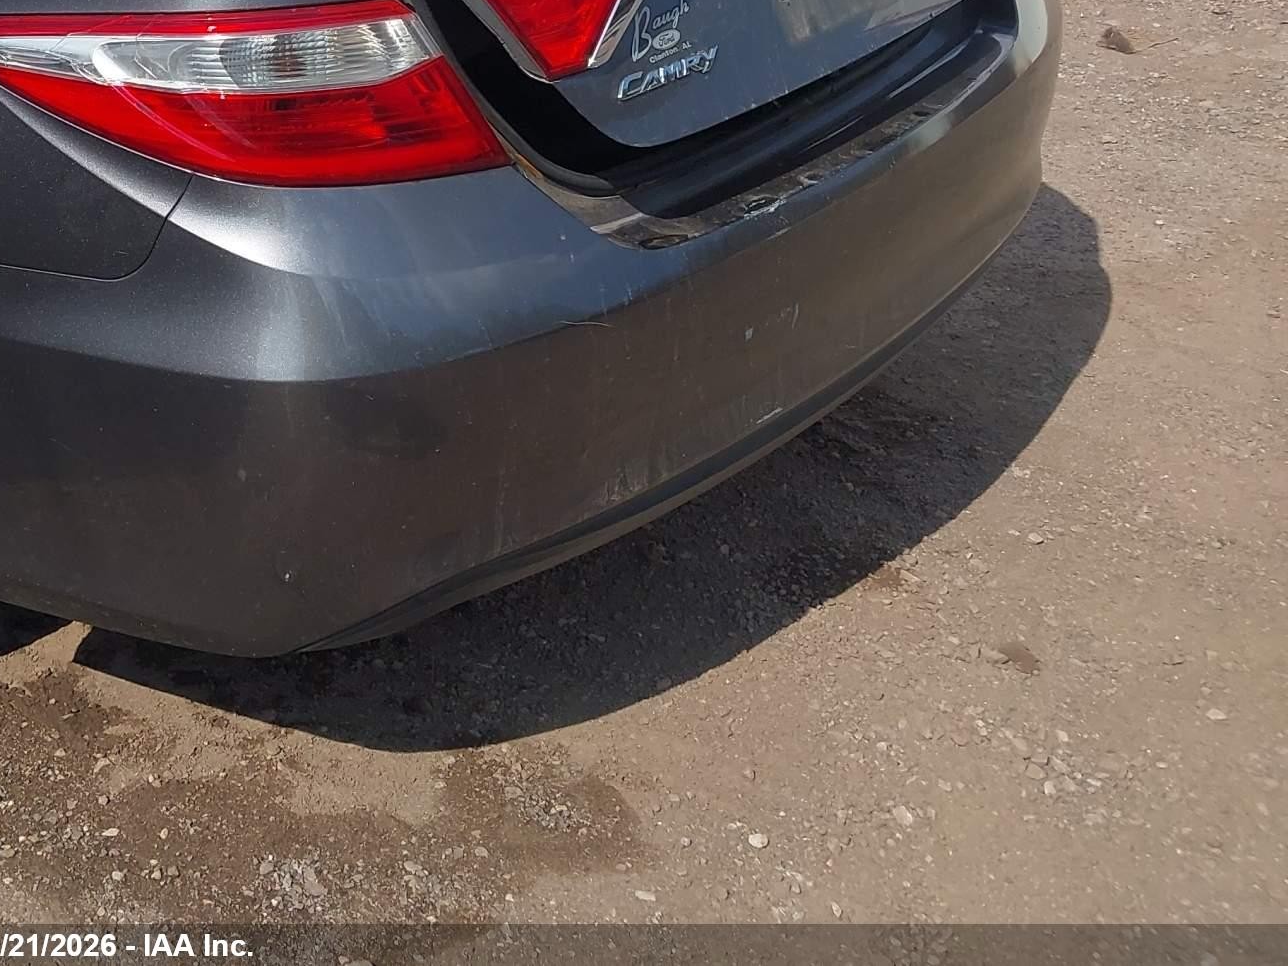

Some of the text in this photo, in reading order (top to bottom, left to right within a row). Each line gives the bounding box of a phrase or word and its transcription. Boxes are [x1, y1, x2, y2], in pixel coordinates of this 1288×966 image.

[649, 41, 692, 63] Clanton AL
[617, 44, 719, 101] CAMRY
